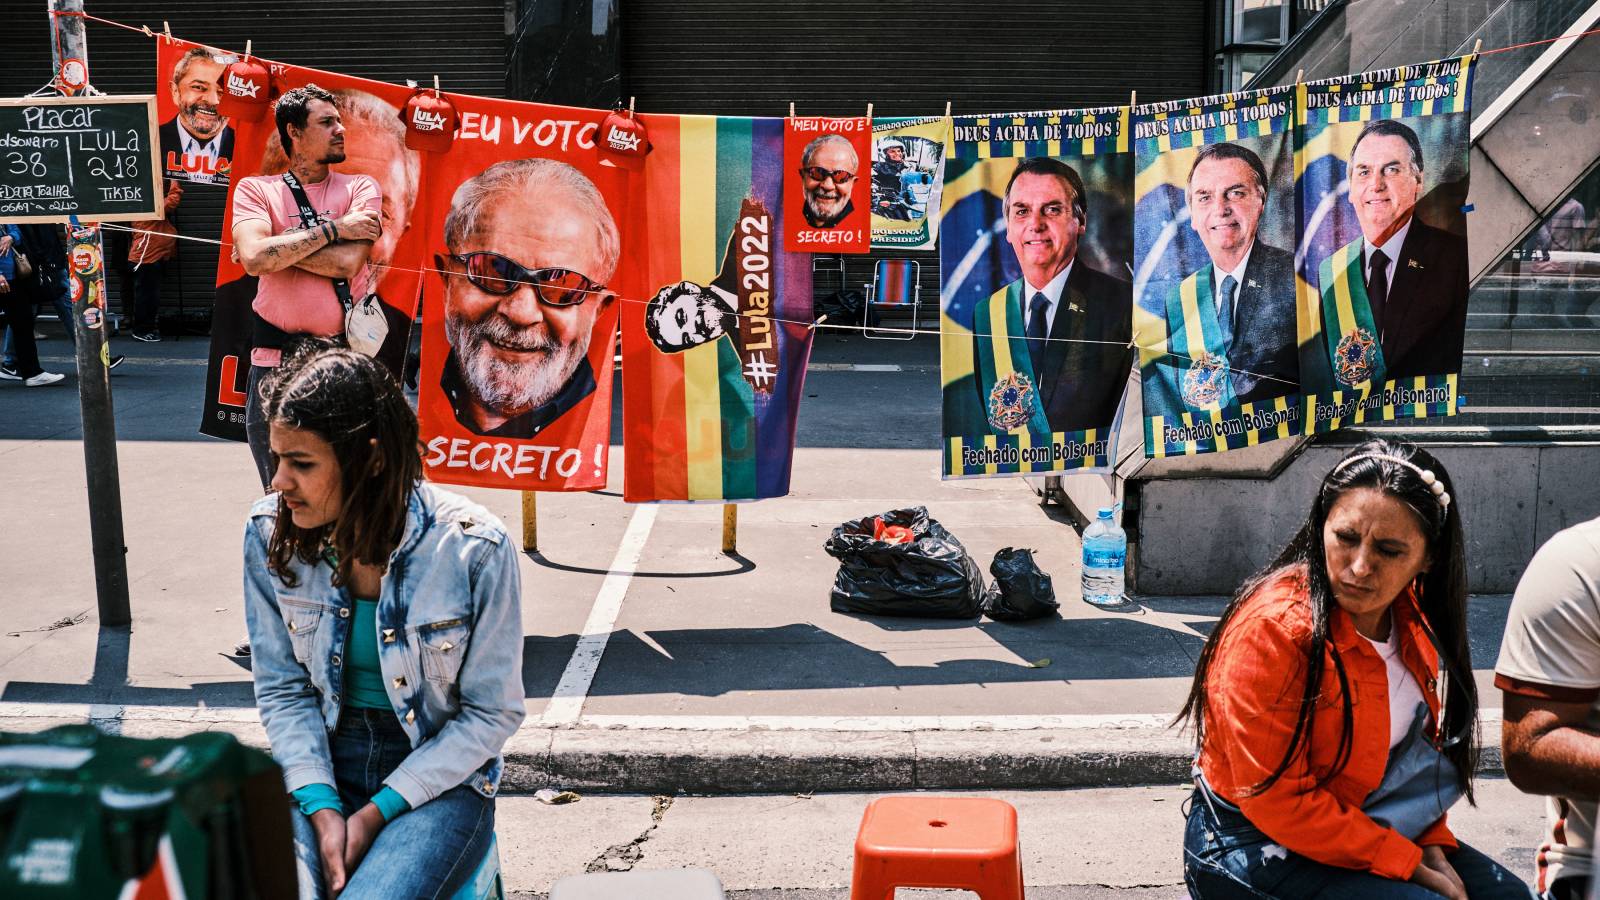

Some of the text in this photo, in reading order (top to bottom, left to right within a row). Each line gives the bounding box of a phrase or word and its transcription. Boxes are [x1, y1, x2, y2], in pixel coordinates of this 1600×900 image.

[271, 64, 284, 75] PT
[1404, 65, 1423, 81] DE
[226, 71, 261, 98] LULA
[1307, 93, 1341, 109] DEUS
[1343, 89, 1385, 107] ACIMA
[1388, 87, 1406, 104] DE
[1409, 83, 1450, 101] TODOS
[412, 105, 448, 131] LULA
[415, 123, 431, 131] 2022
[794, 120, 818, 132] MEU
[821, 120, 854, 133] VOTO
[1135, 120, 1169, 140] DEUS
[1173, 112, 1216, 134] ACIMA
[1219, 108, 1238, 126] DE
[1241, 101, 1287, 123] TODOS
[453, 112, 599, 152] EU VOTO
[607, 125, 642, 151] LULA
[954, 125, 991, 142] DEUS
[994, 124, 1039, 142] ACIMA
[1044, 123, 1062, 141] DE
[1066, 122, 1112, 140] TODOS
[6, 152, 47, 177] 38
[87, 154, 139, 180] 218
[797, 230, 854, 244] SECRETO
[740, 215, 777, 388] #Lula2022
[1358, 392, 1382, 411] com
[1383, 383, 1451, 407] Bolsonaro!
[217, 410, 226, 421] O
[1163, 418, 1213, 444] Fechado
[1214, 419, 1243, 441] com
[426, 436, 582, 480] SECRETO
[962, 443, 1019, 466] Fechado
[1021, 447, 1050, 463] com
